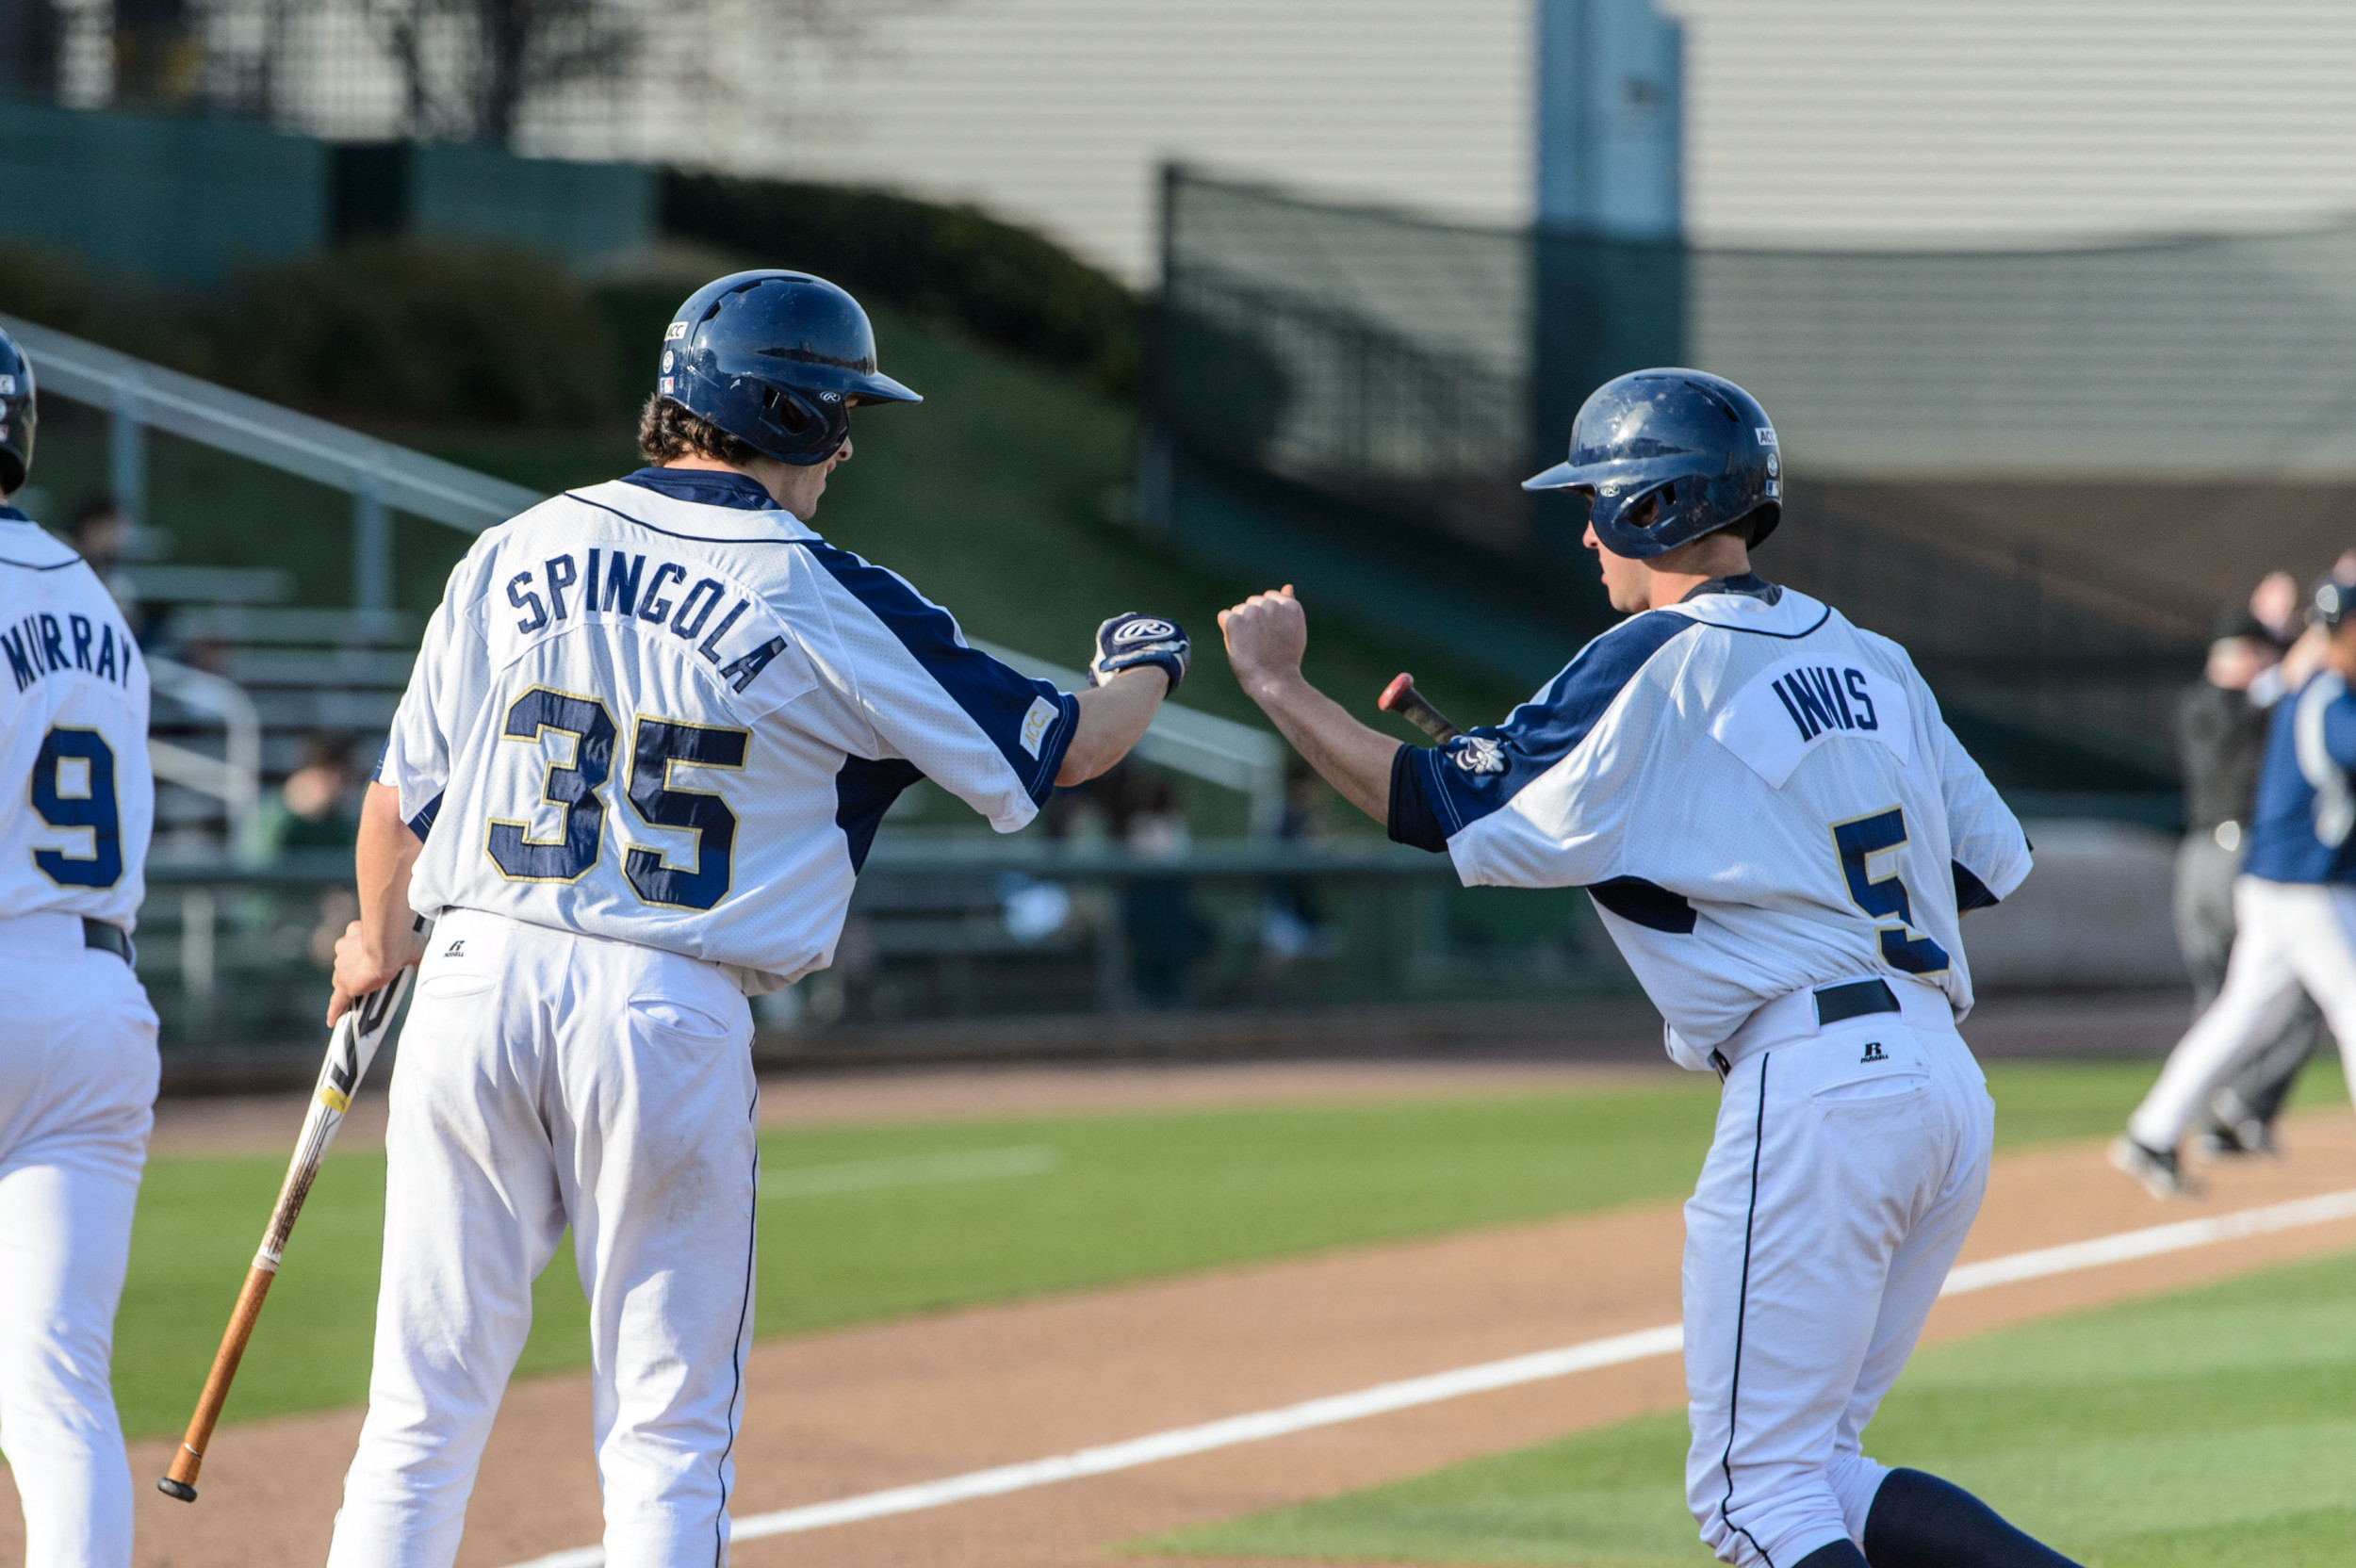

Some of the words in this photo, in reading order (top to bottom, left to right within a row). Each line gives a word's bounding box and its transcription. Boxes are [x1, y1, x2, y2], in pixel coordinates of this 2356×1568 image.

[664, 324, 684, 337] ACC
[1, 613, 131, 694] MURRAY
[506, 548, 788, 694] SPINGOLA
[1772, 667, 1878, 743] INVIS
[28, 723, 126, 890] 9
[484, 683, 754, 912] 35
[1828, 803, 1951, 977] 5
